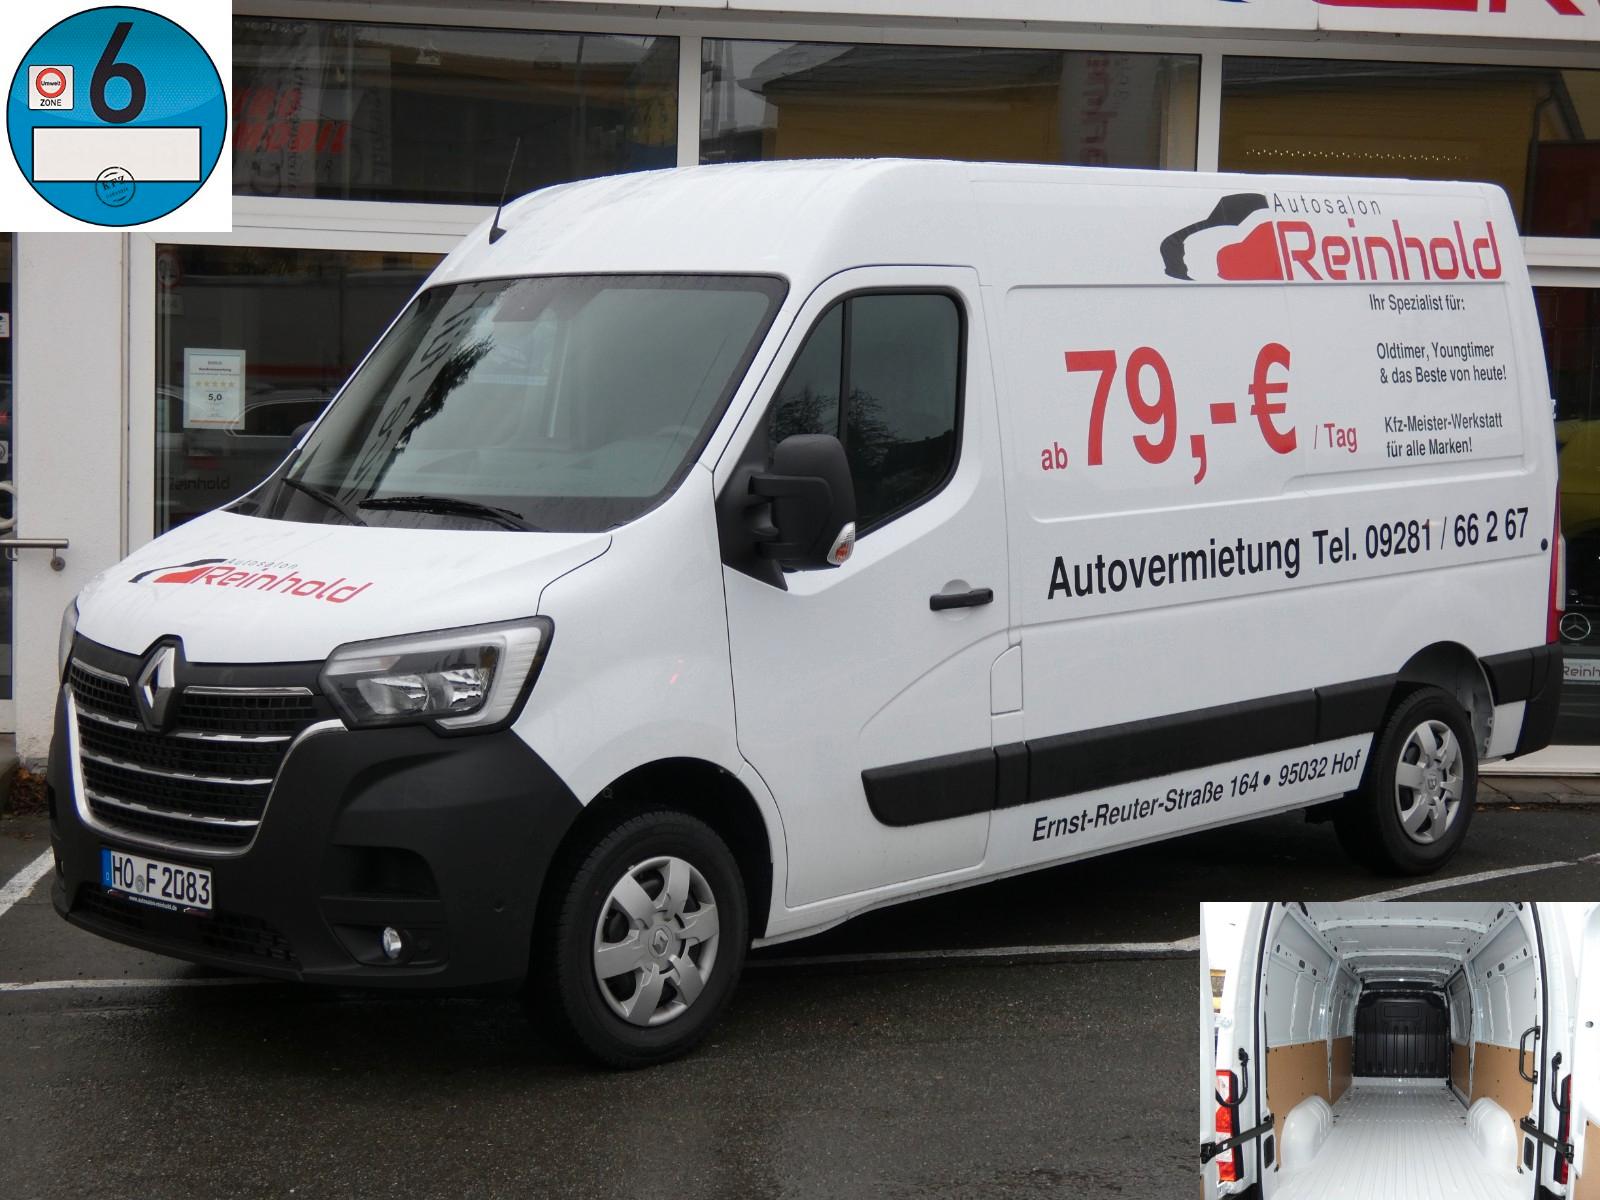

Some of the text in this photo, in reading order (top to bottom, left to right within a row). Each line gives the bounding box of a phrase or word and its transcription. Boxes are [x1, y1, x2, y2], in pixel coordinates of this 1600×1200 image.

[1273, 192, 1382, 215] Autosalon
[1276, 217, 1502, 281] Reinhold
[1369, 293, 1465, 315] Ihr Spezialist für:
[1377, 341, 1494, 362] Oldtimer, Youngtimer
[1380, 364, 1507, 384] & das Beste von heute!
[208, 393, 223, 402] 5,0
[1385, 412, 1503, 433] Kfz-Meister-Werkstatt
[1041, 441, 1068, 470] ab
[1323, 423, 1357, 453] Tag
[1387, 437, 1473, 458] für alle Marken!
[1047, 536, 1301, 600] Autovermietung
[1313, 527, 1358, 566] Tel.
[1365, 519, 1432, 560] 09281
[1453, 513, 1479, 548] 66
[1486, 510, 1499, 543] 2
[1504, 507, 1529, 540] 67
[191, 566, 374, 604] Reinhold
[1032, 781, 1223, 842] Ernst-Reuter-Straße
[1230, 770, 1259, 798] 164
[1278, 756, 1329, 787] 95032
[1331, 748, 1362, 776] Hof
[112, 855, 210, 905] HO F 2083
